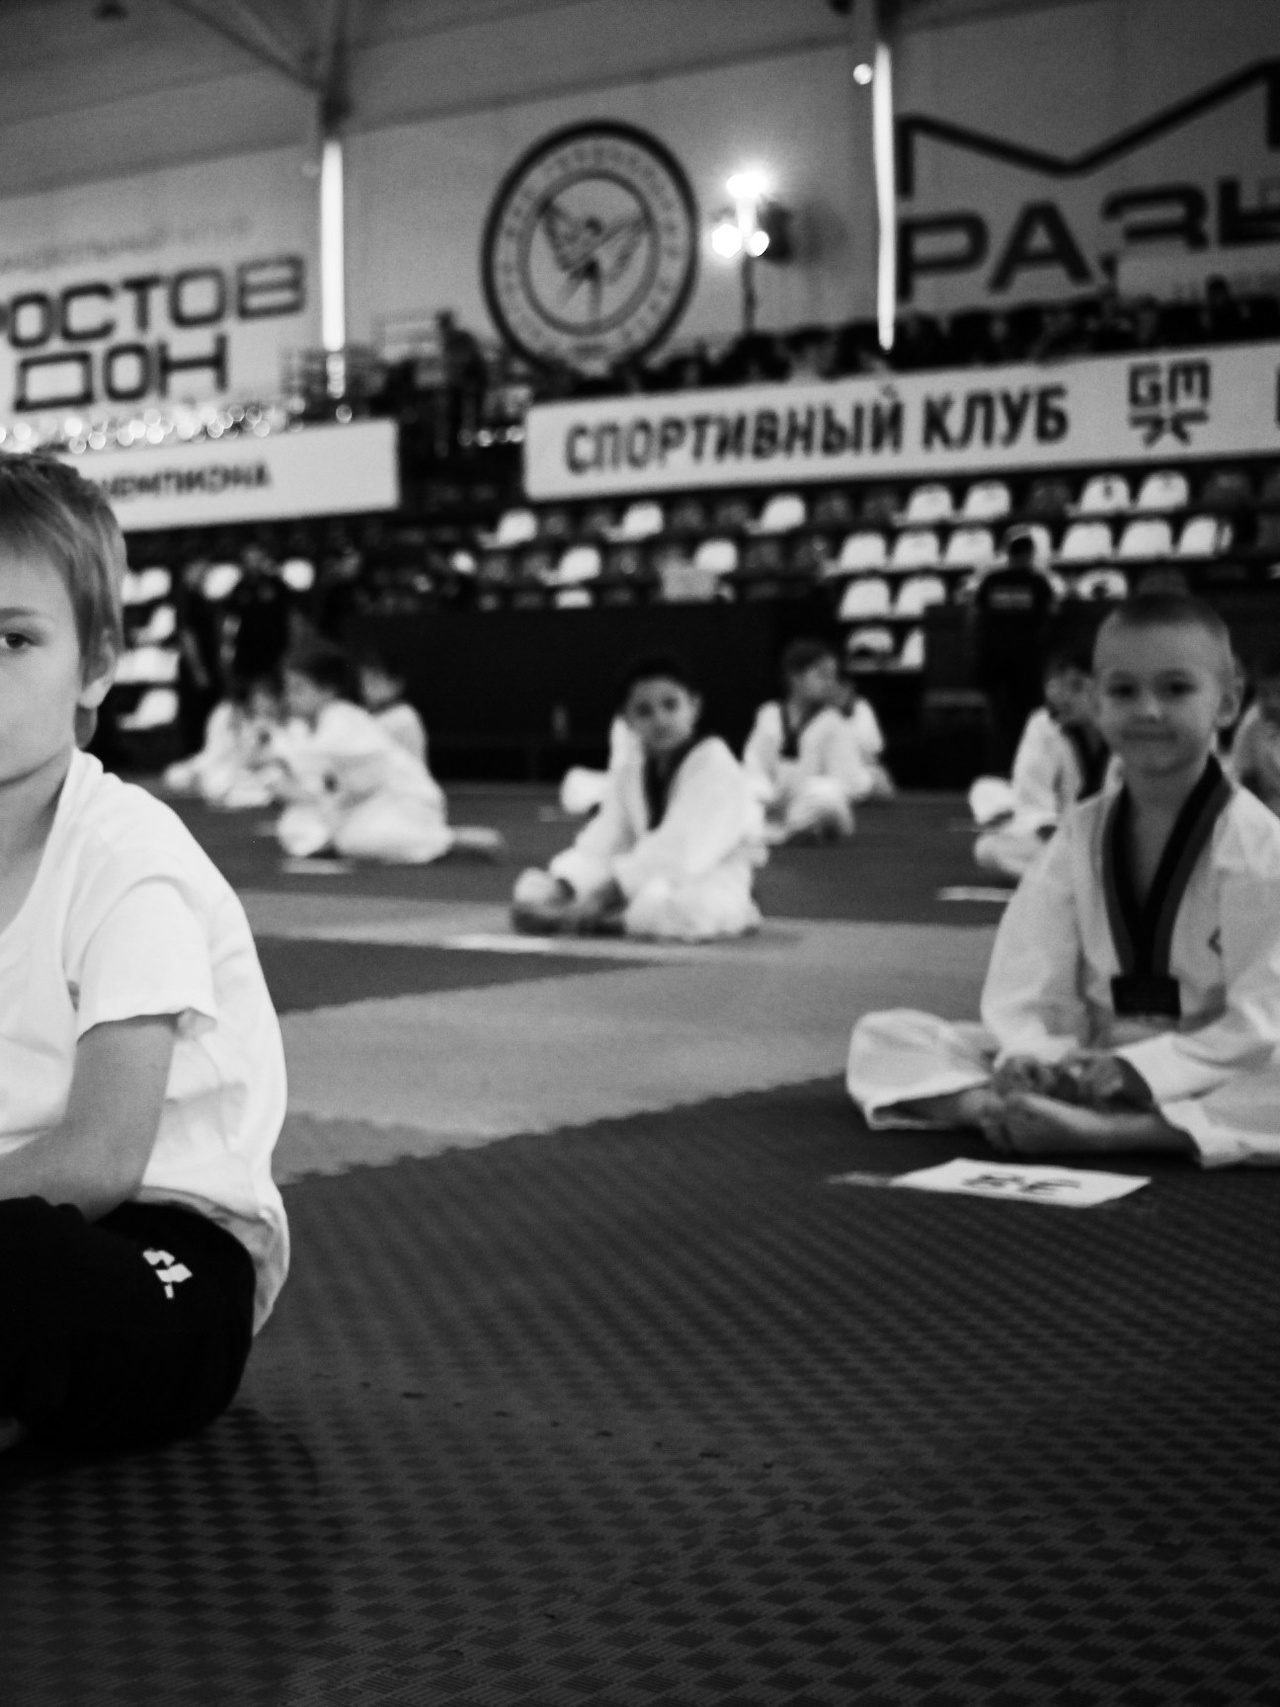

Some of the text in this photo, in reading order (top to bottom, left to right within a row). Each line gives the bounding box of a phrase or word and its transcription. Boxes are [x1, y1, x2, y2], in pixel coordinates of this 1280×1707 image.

[14, 332, 228, 412] ДОН
[564, 383, 1069, 475] СПОРТИВНЫЙ КЛУБ
